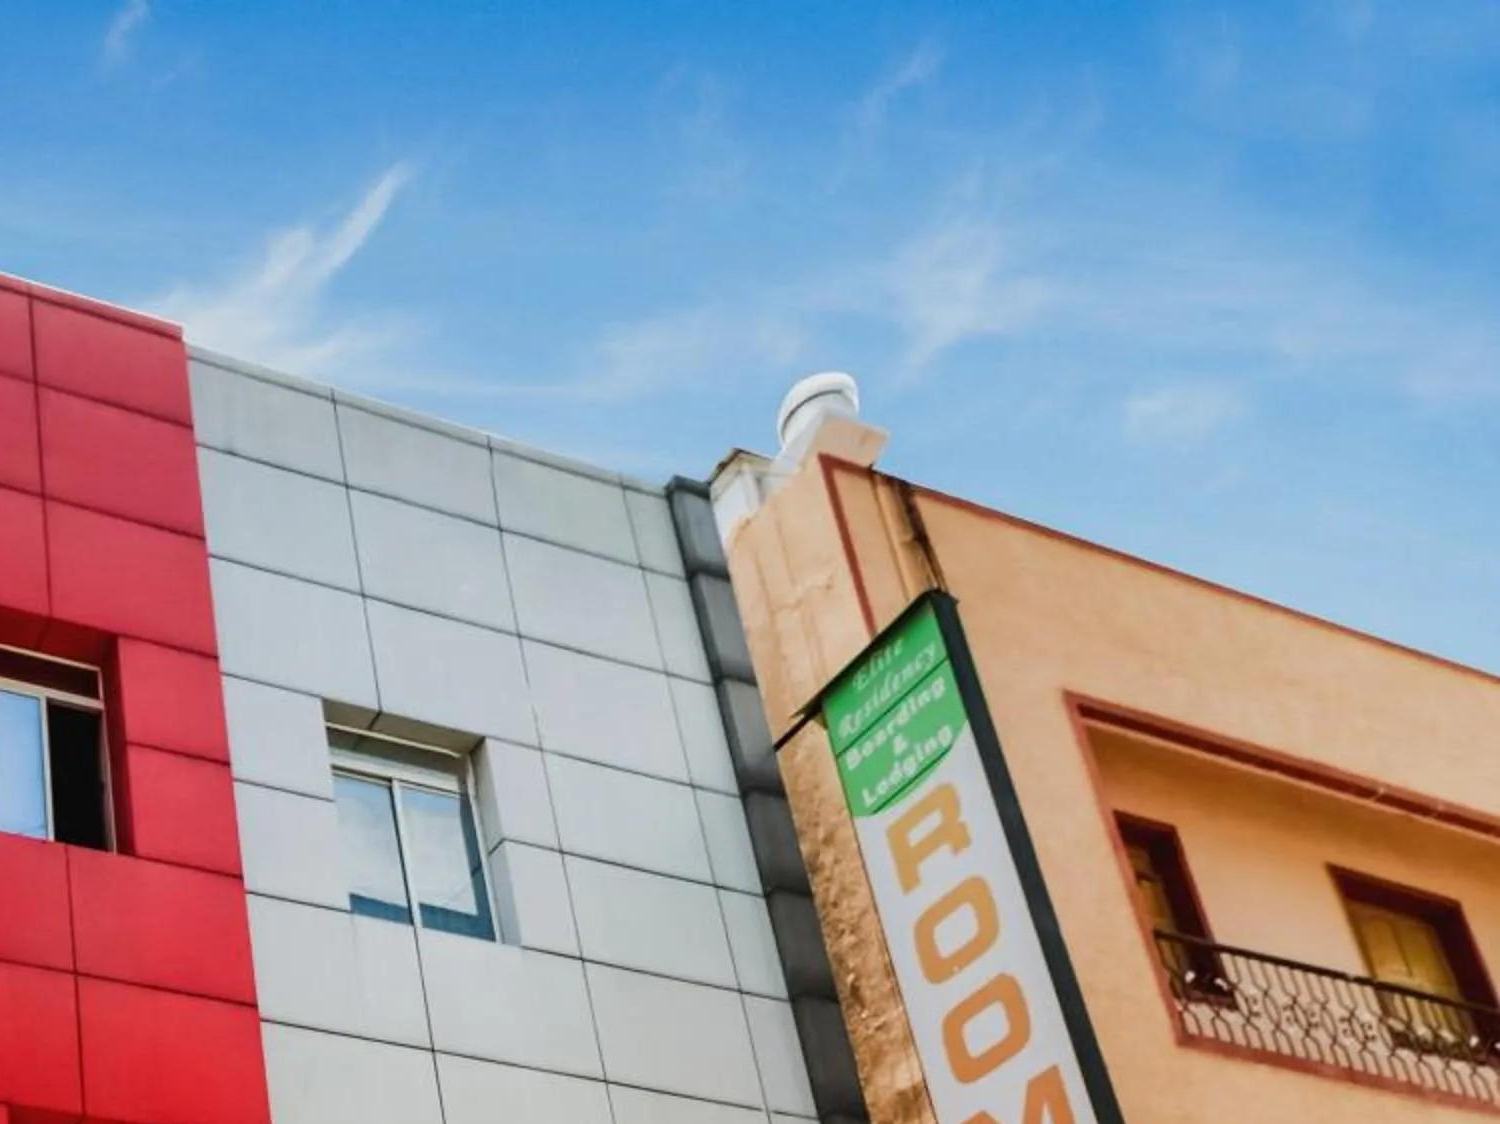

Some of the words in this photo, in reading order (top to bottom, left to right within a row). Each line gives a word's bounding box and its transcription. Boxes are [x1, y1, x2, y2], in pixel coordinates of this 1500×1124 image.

[838, 642, 937, 740] Residency
[845, 677, 946, 771] Boarding
[861, 725, 953, 807] Lodging
